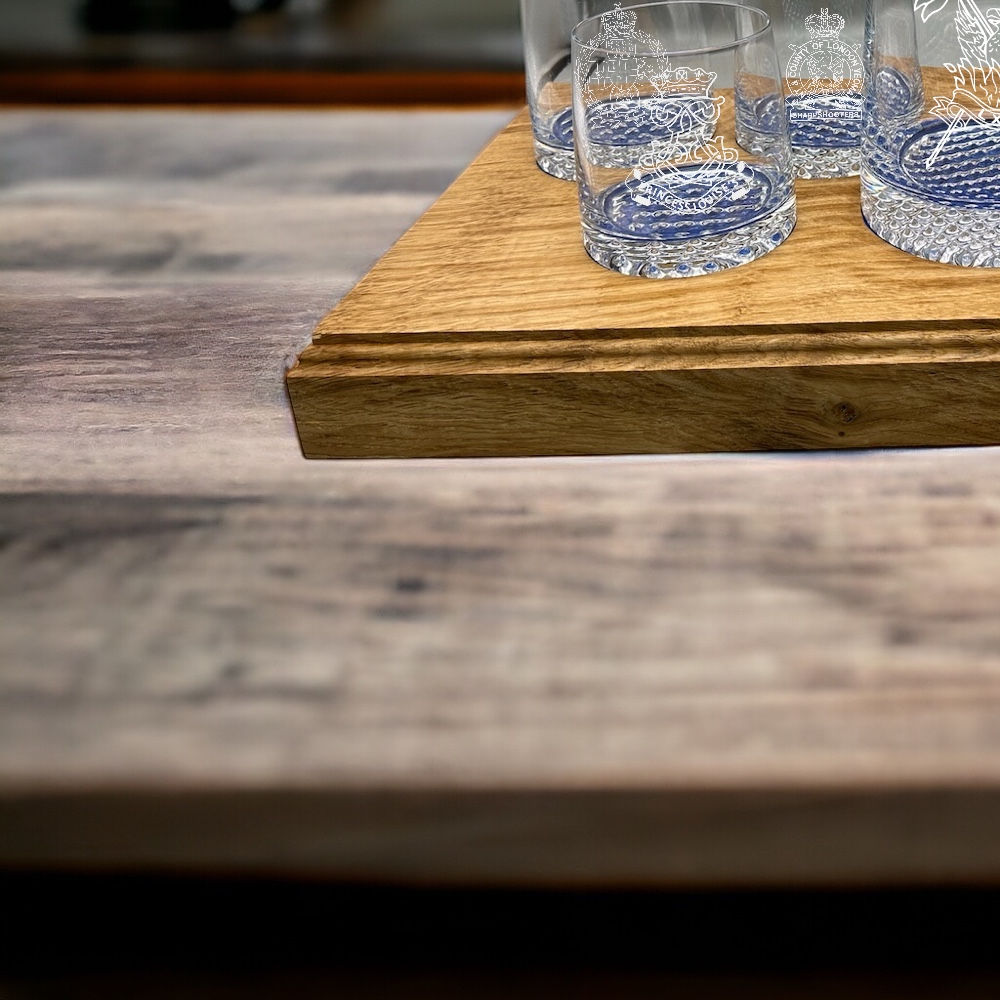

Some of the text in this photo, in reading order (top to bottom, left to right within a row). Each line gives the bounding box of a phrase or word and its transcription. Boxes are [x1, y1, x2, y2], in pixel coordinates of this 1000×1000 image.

[789, 46, 811, 78] COUNTY
[811, 41, 824, 50] OF
[827, 41, 859, 67] LONDON
